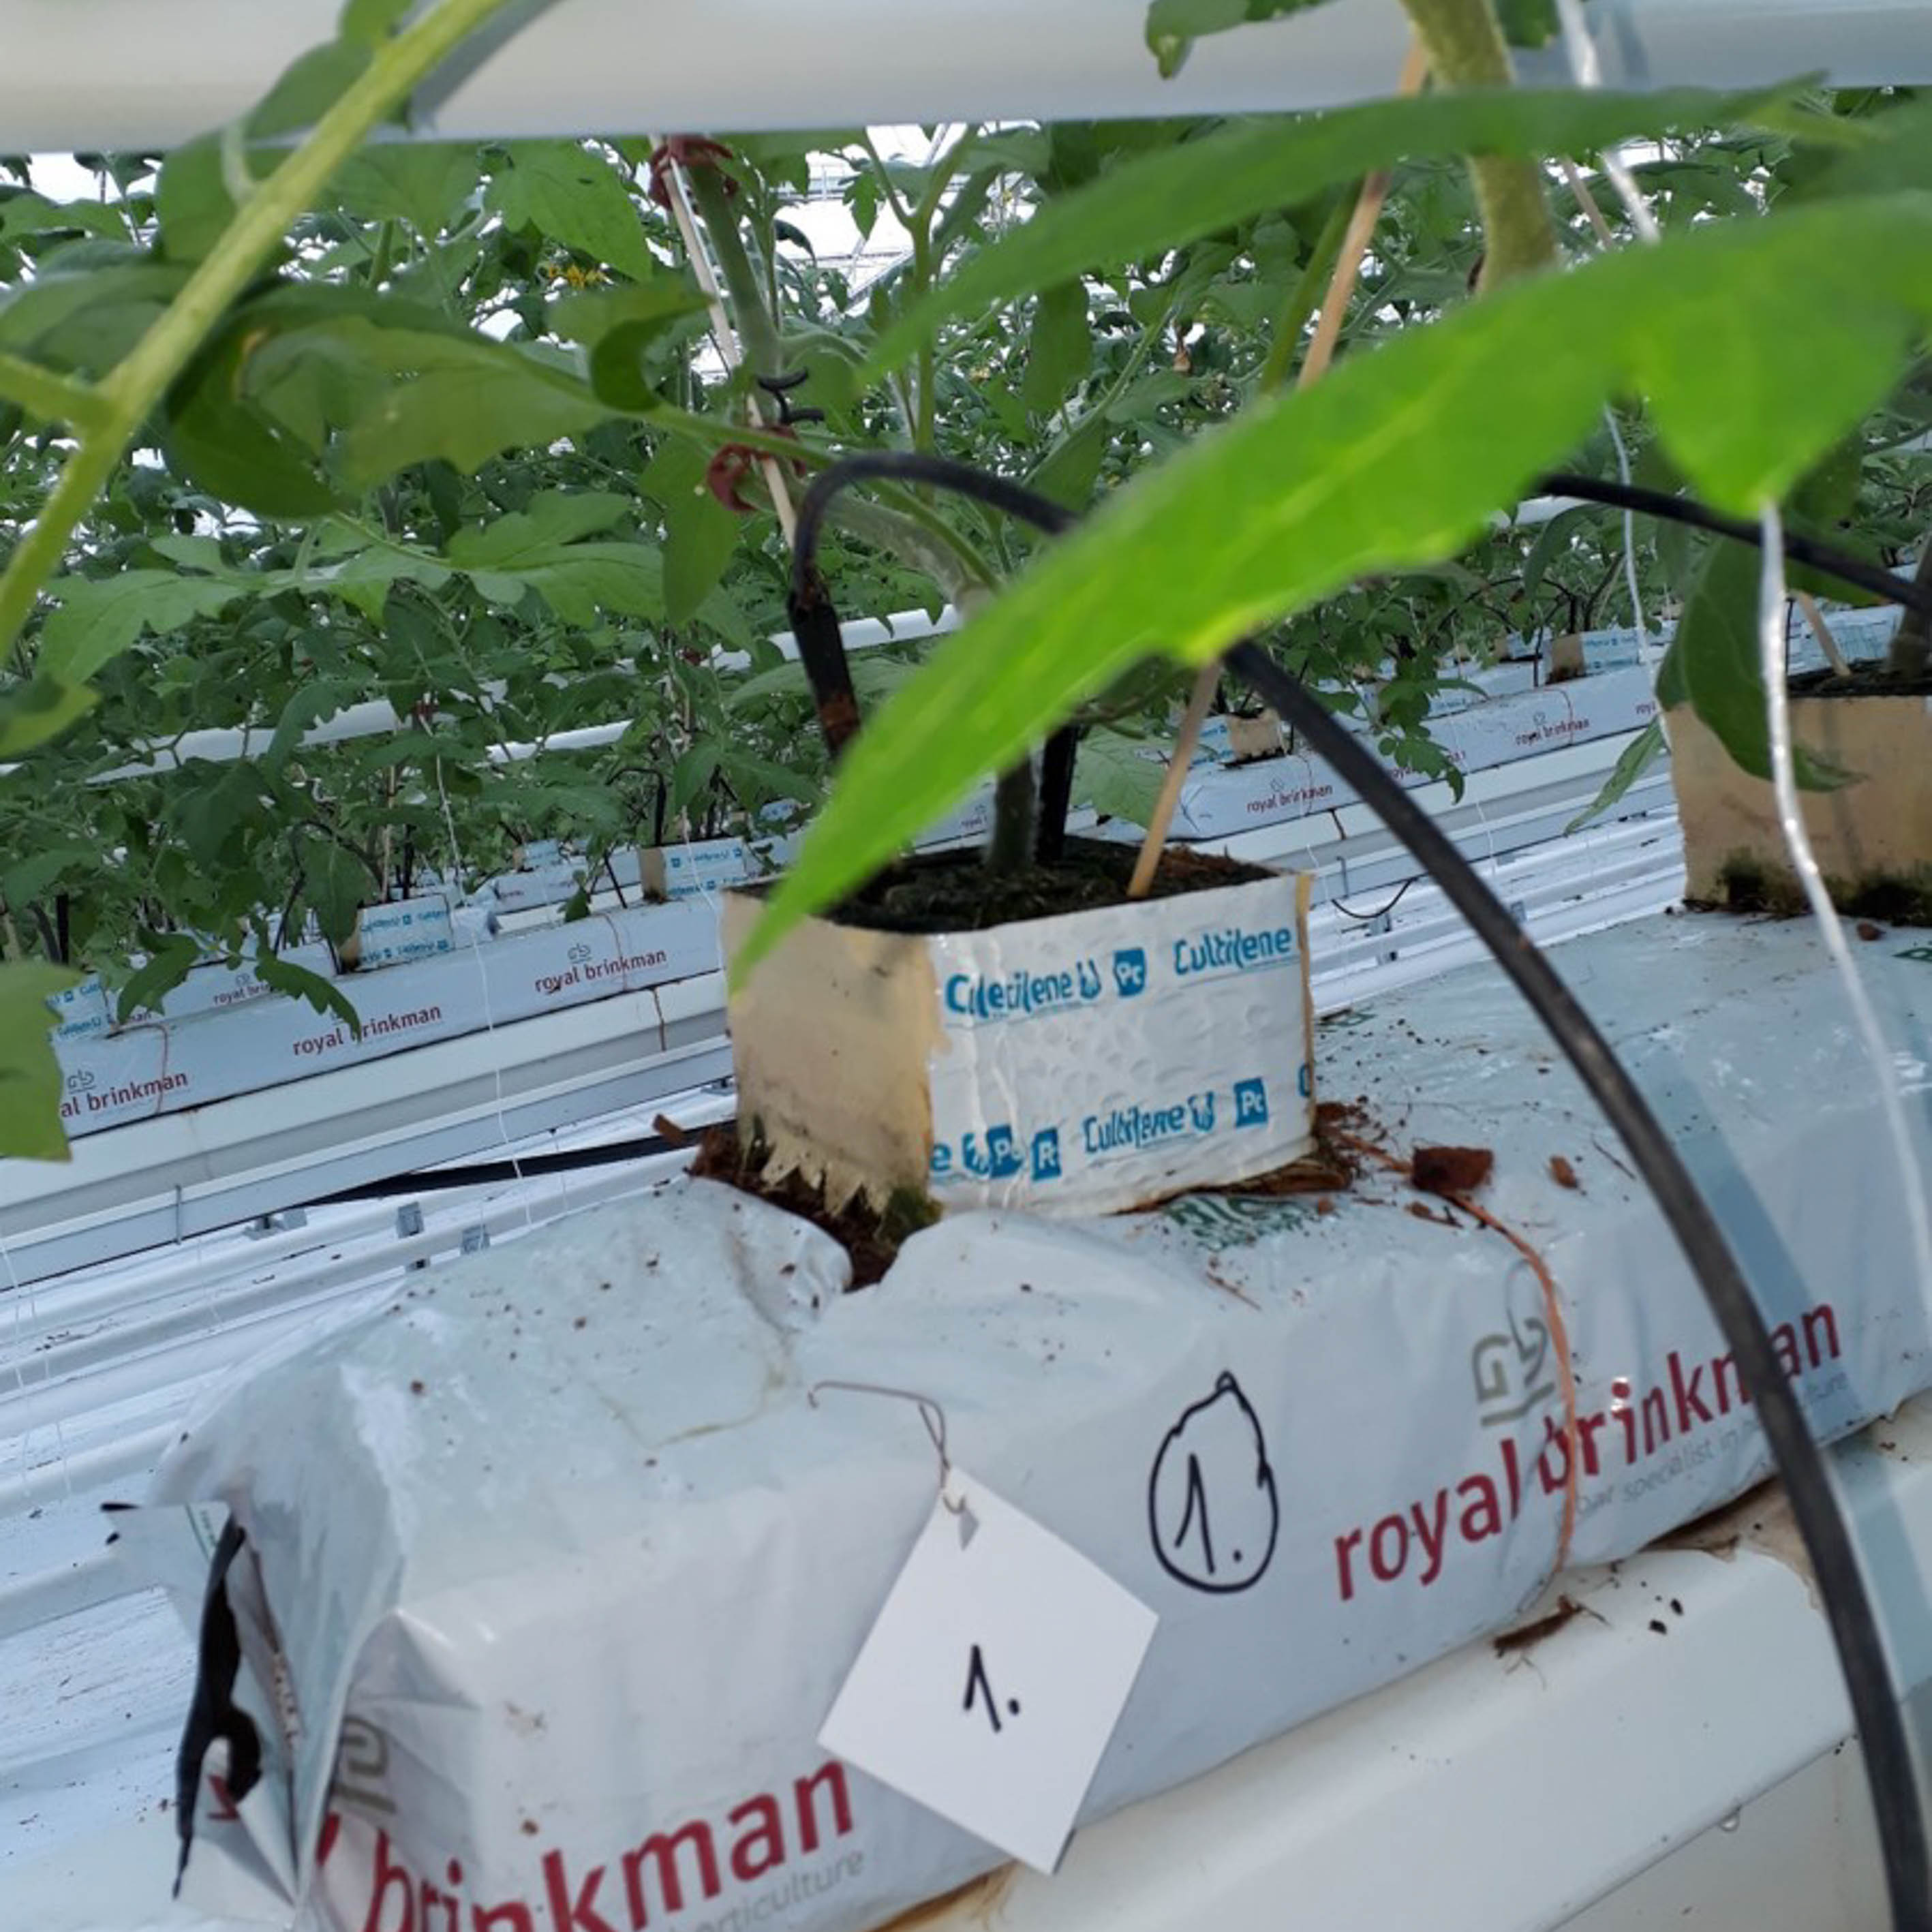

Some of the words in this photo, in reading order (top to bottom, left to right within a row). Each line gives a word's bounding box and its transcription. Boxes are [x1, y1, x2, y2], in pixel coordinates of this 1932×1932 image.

[1246, 794, 1276, 814] royal
[535, 967, 580, 994] royal
[585, 949, 667, 981] brinkman
[1174, 927, 1291, 975] Cultilene
[292, 1028, 344, 1057] royal
[350, 1005, 442, 1043] rinkman
[86, 1072, 189, 1111] brinkman
[1174, 1453, 1243, 1575] 1.
[1333, 1439, 1522, 1602] royal
[963, 1642, 1020, 1733] 1.
